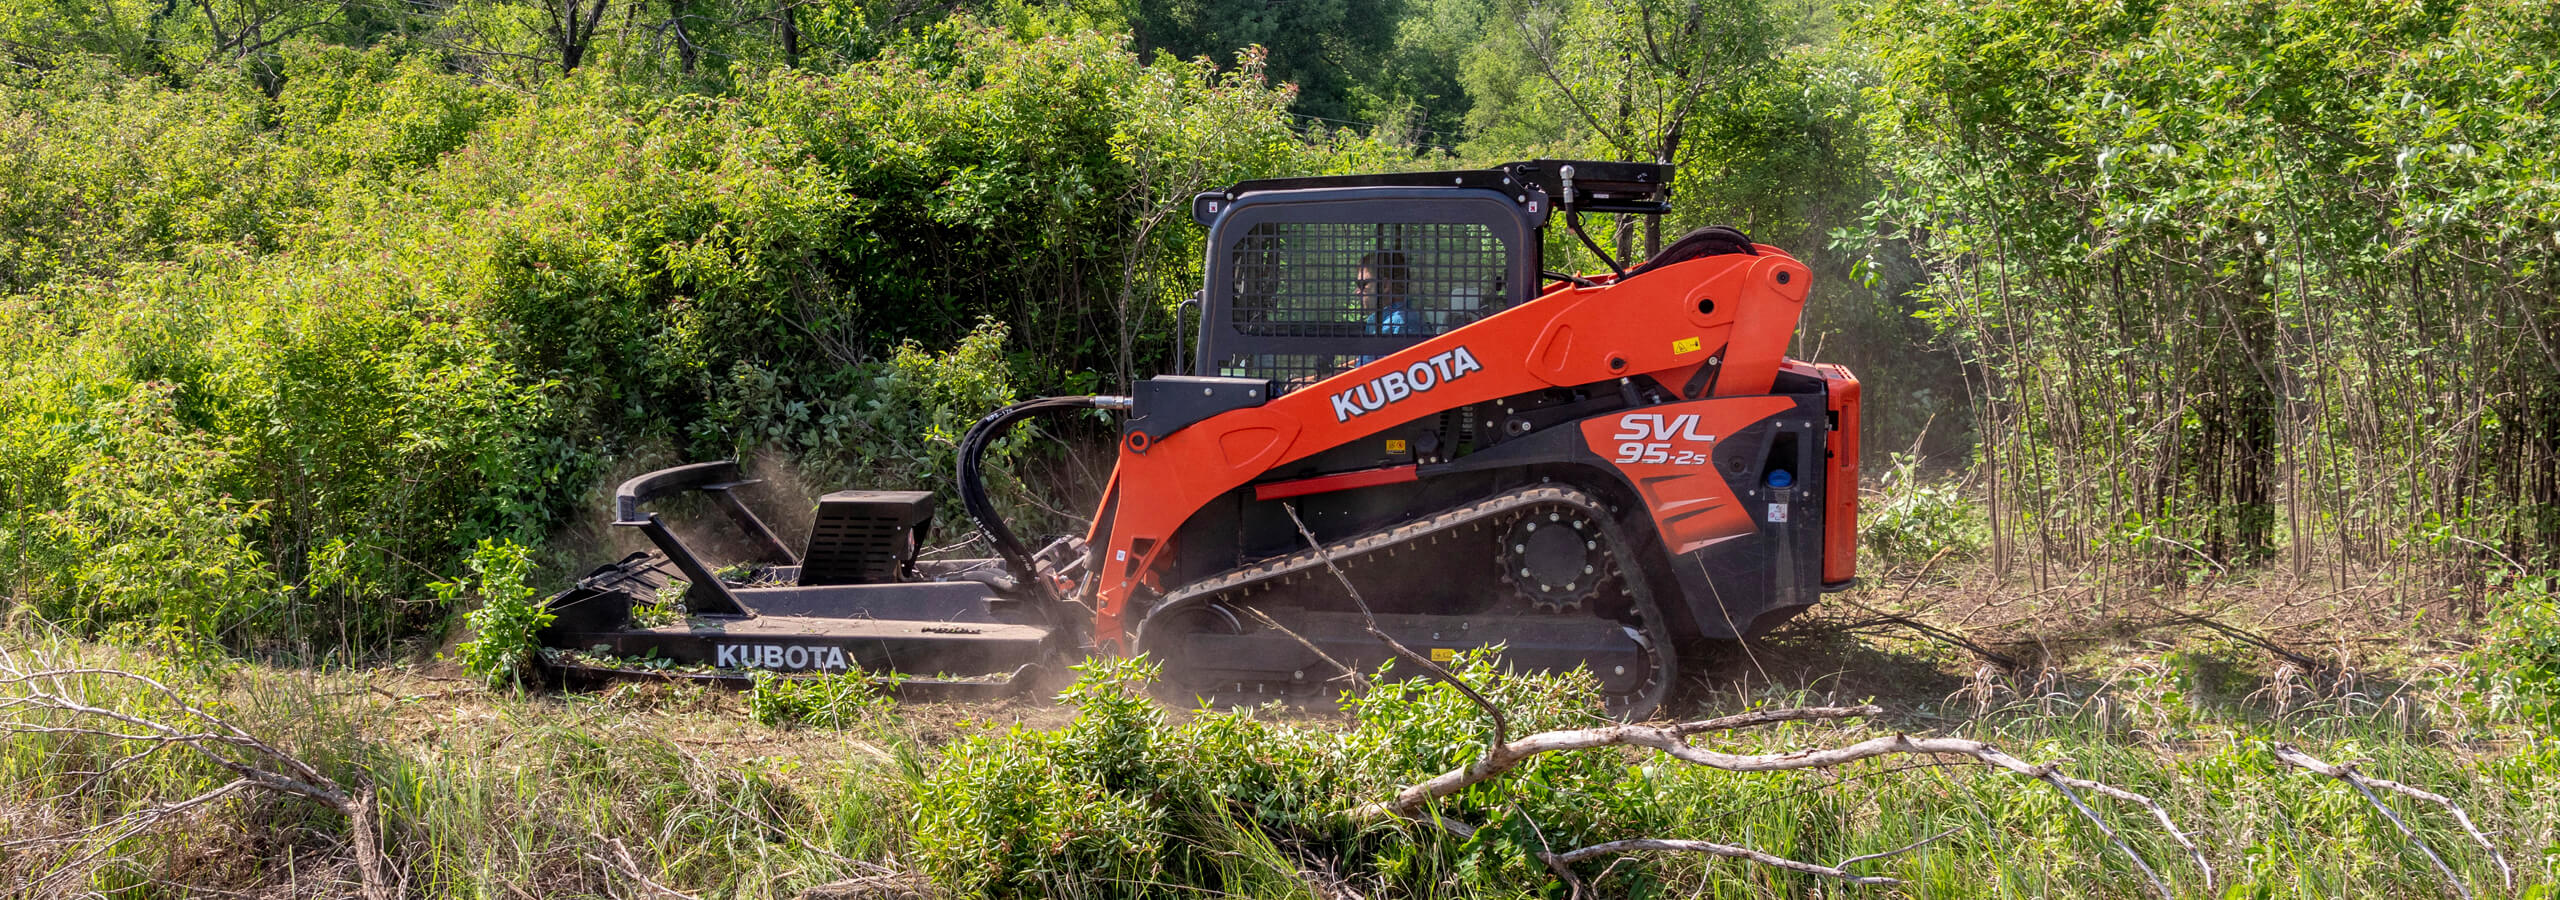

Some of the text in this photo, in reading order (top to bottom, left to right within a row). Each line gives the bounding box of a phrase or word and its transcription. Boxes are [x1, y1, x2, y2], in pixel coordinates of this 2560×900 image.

[1330, 346, 1482, 422] KUBOTA
[1613, 413, 1716, 442] SVL
[717, 644, 847, 669] KUBOTA
